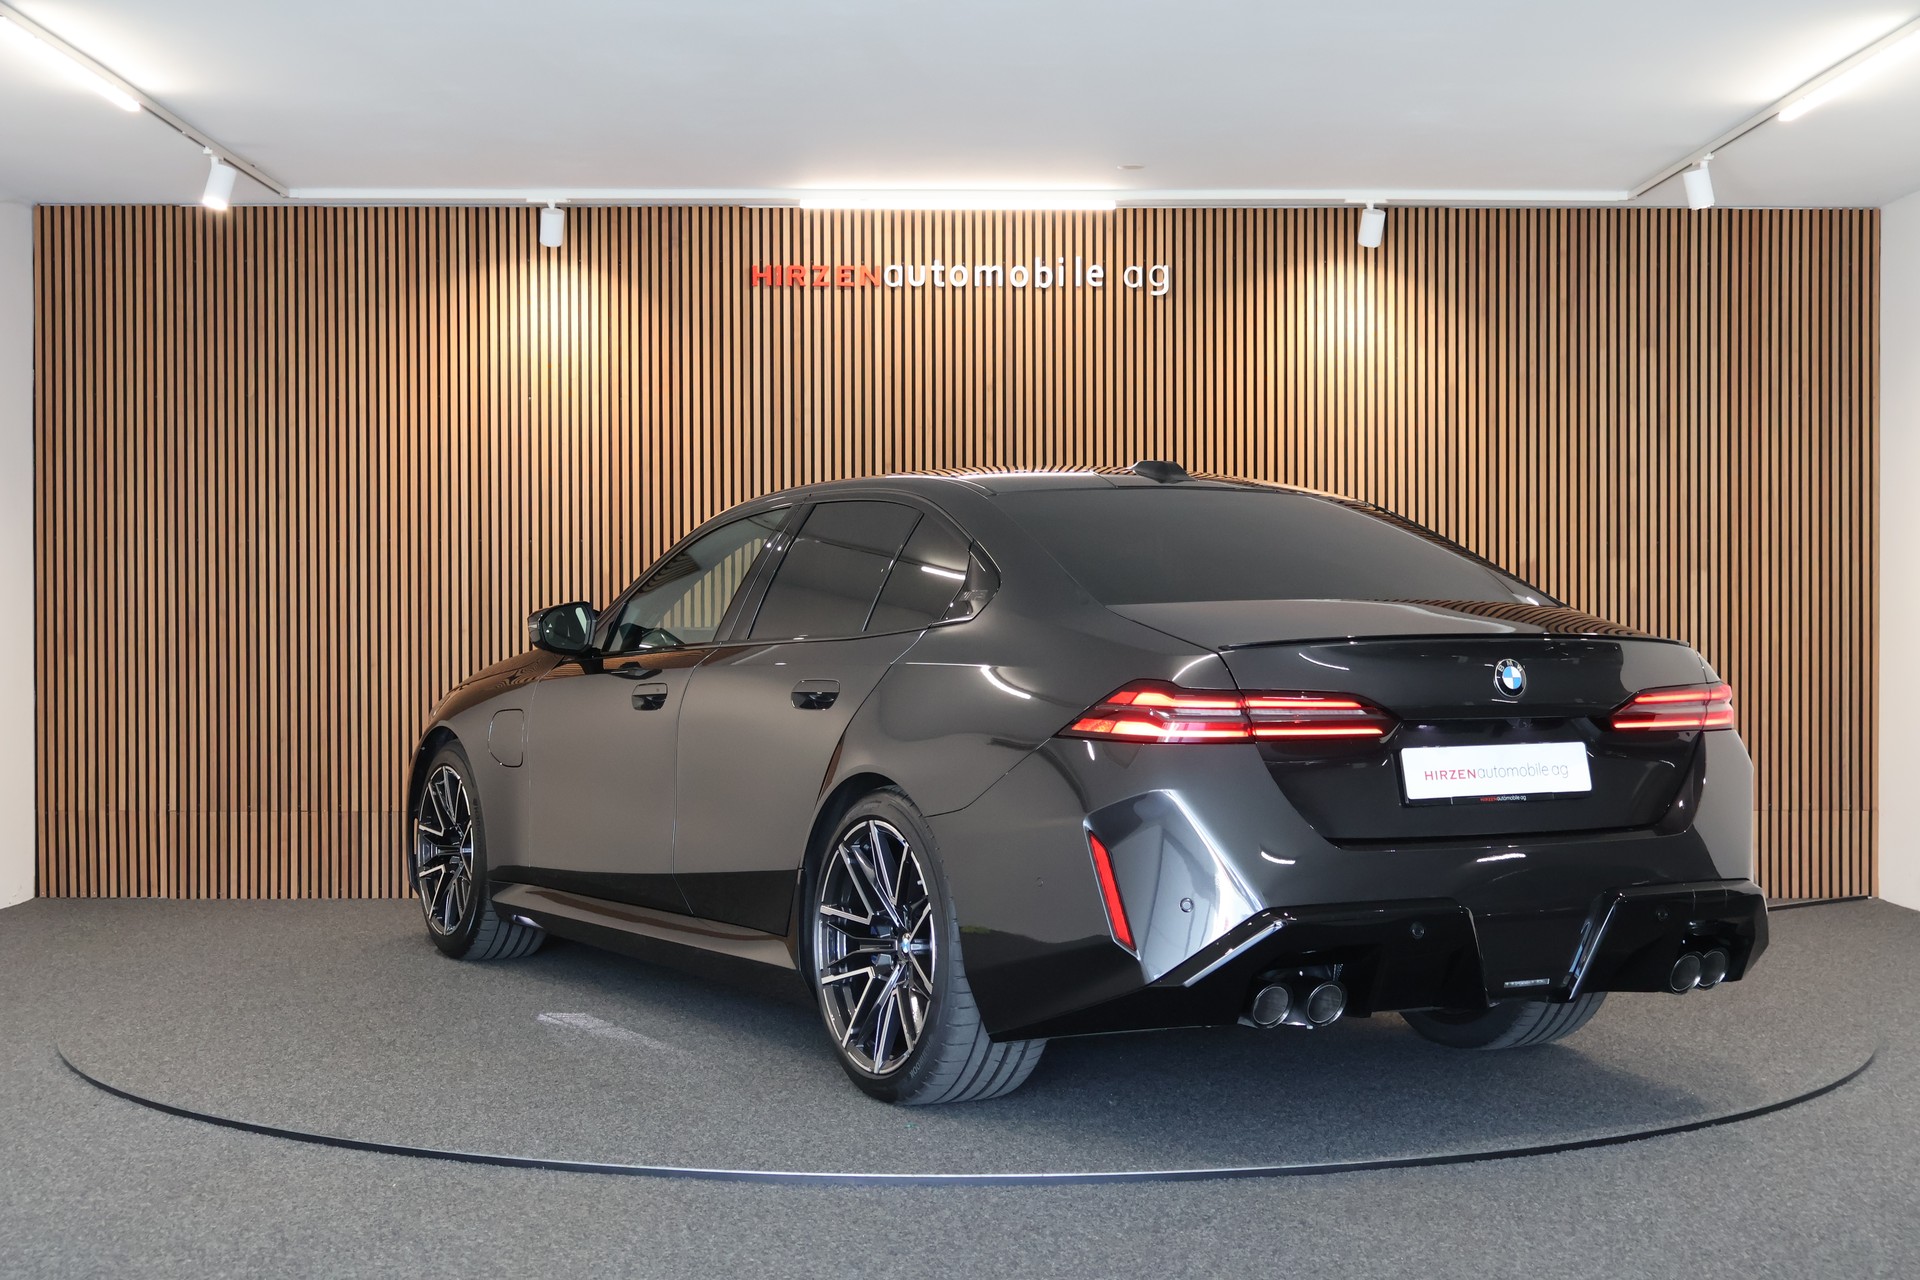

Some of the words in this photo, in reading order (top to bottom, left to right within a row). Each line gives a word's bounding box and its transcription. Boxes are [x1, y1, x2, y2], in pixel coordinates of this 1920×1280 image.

[751, 257, 1105, 288] HIRZENautomobile
[1123, 264, 1170, 296] ag
[1497, 659, 1524, 672] BMW
[1424, 762, 1549, 781] HIRZENautomobile
[1552, 764, 1569, 779] ag
